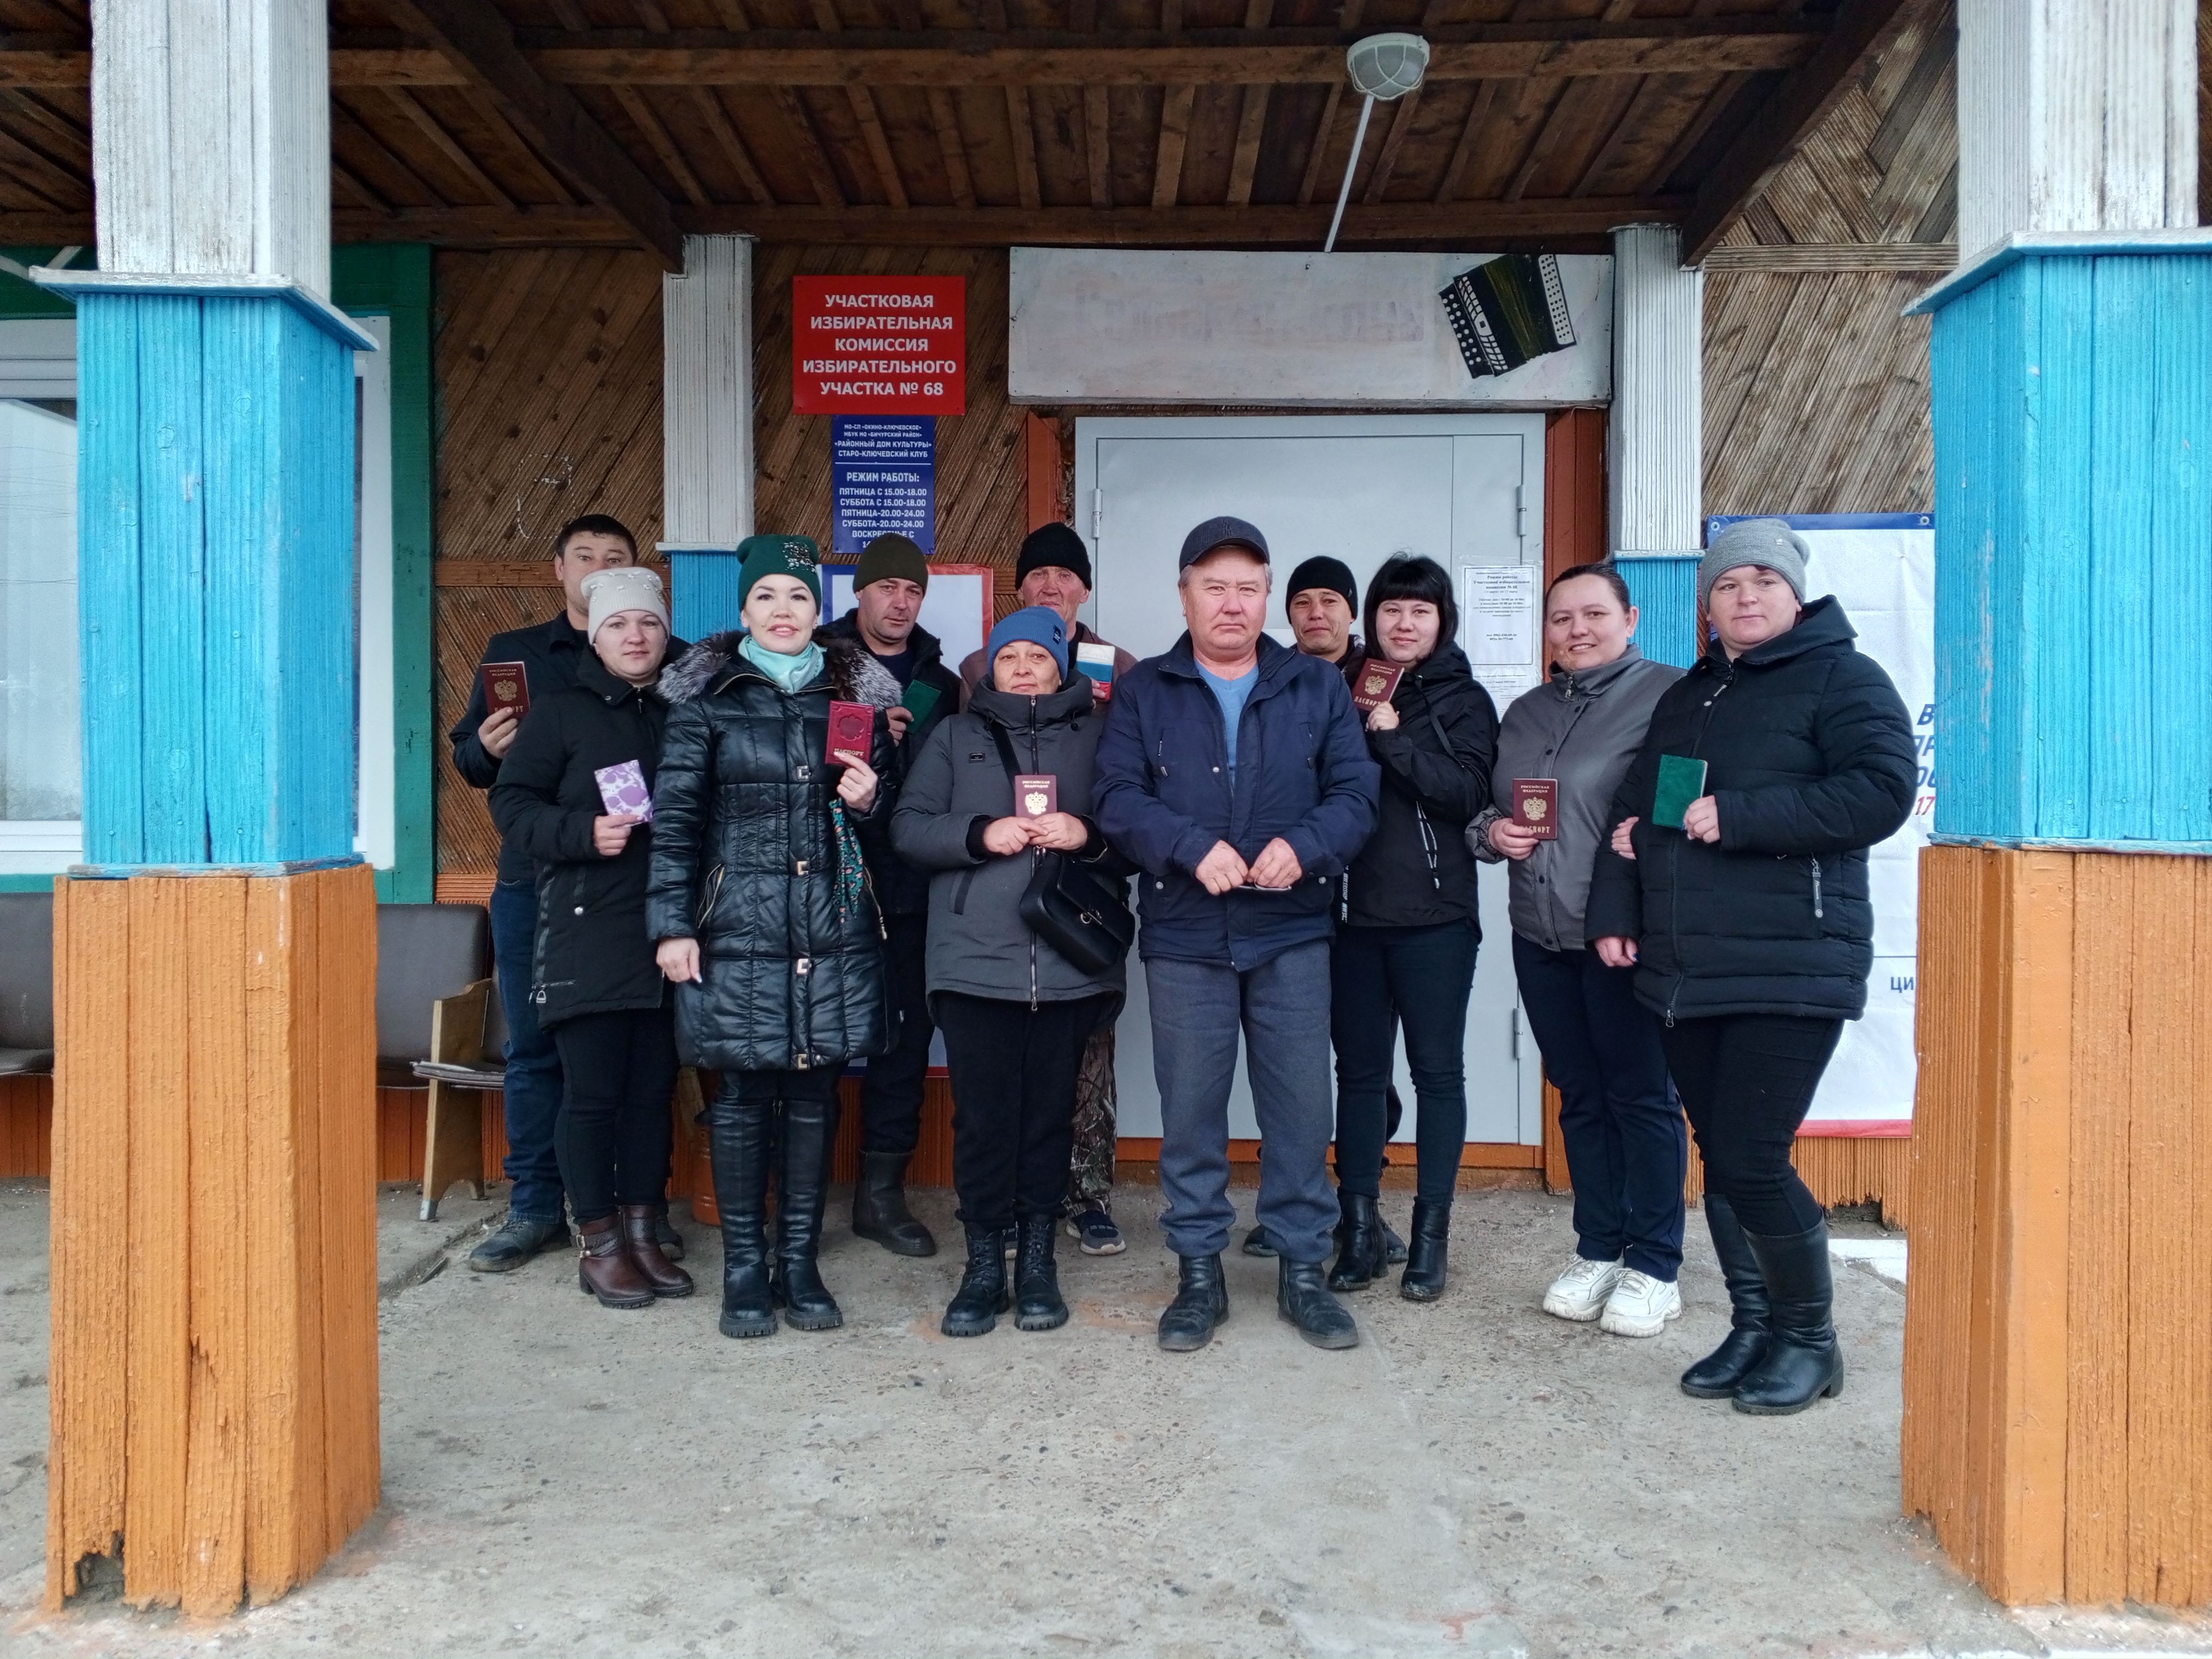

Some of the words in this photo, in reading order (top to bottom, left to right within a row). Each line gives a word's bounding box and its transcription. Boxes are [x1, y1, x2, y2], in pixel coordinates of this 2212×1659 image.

[825, 294, 933, 308] УЧАСТКОВАЯ
[810, 316, 953, 329] ИЗБИРАТЕЛЬНАЯ
[835, 338, 928, 351] КОМИССИЯ
[803, 360, 956, 373] ИЗБИРАТЕЛЬНОГО
[820, 382, 895, 395] УЧАСТКА
[900, 382, 918, 395] №
[924, 382, 943, 395] 68
[834, 439, 875, 447] «РАЙОННЫЙ
[847, 472, 879, 482] РЕЖИМ
[881, 472, 920, 482] РАБОТЫ:
[839, 488, 876, 496] ПЯТНИЦА
[841, 509, 925, 518] ПЯТНИЦА-20.00-24.00
[842, 519, 924, 528] СУББОТА-20.00-24.00
[1915, 796, 1936, 816] 17
